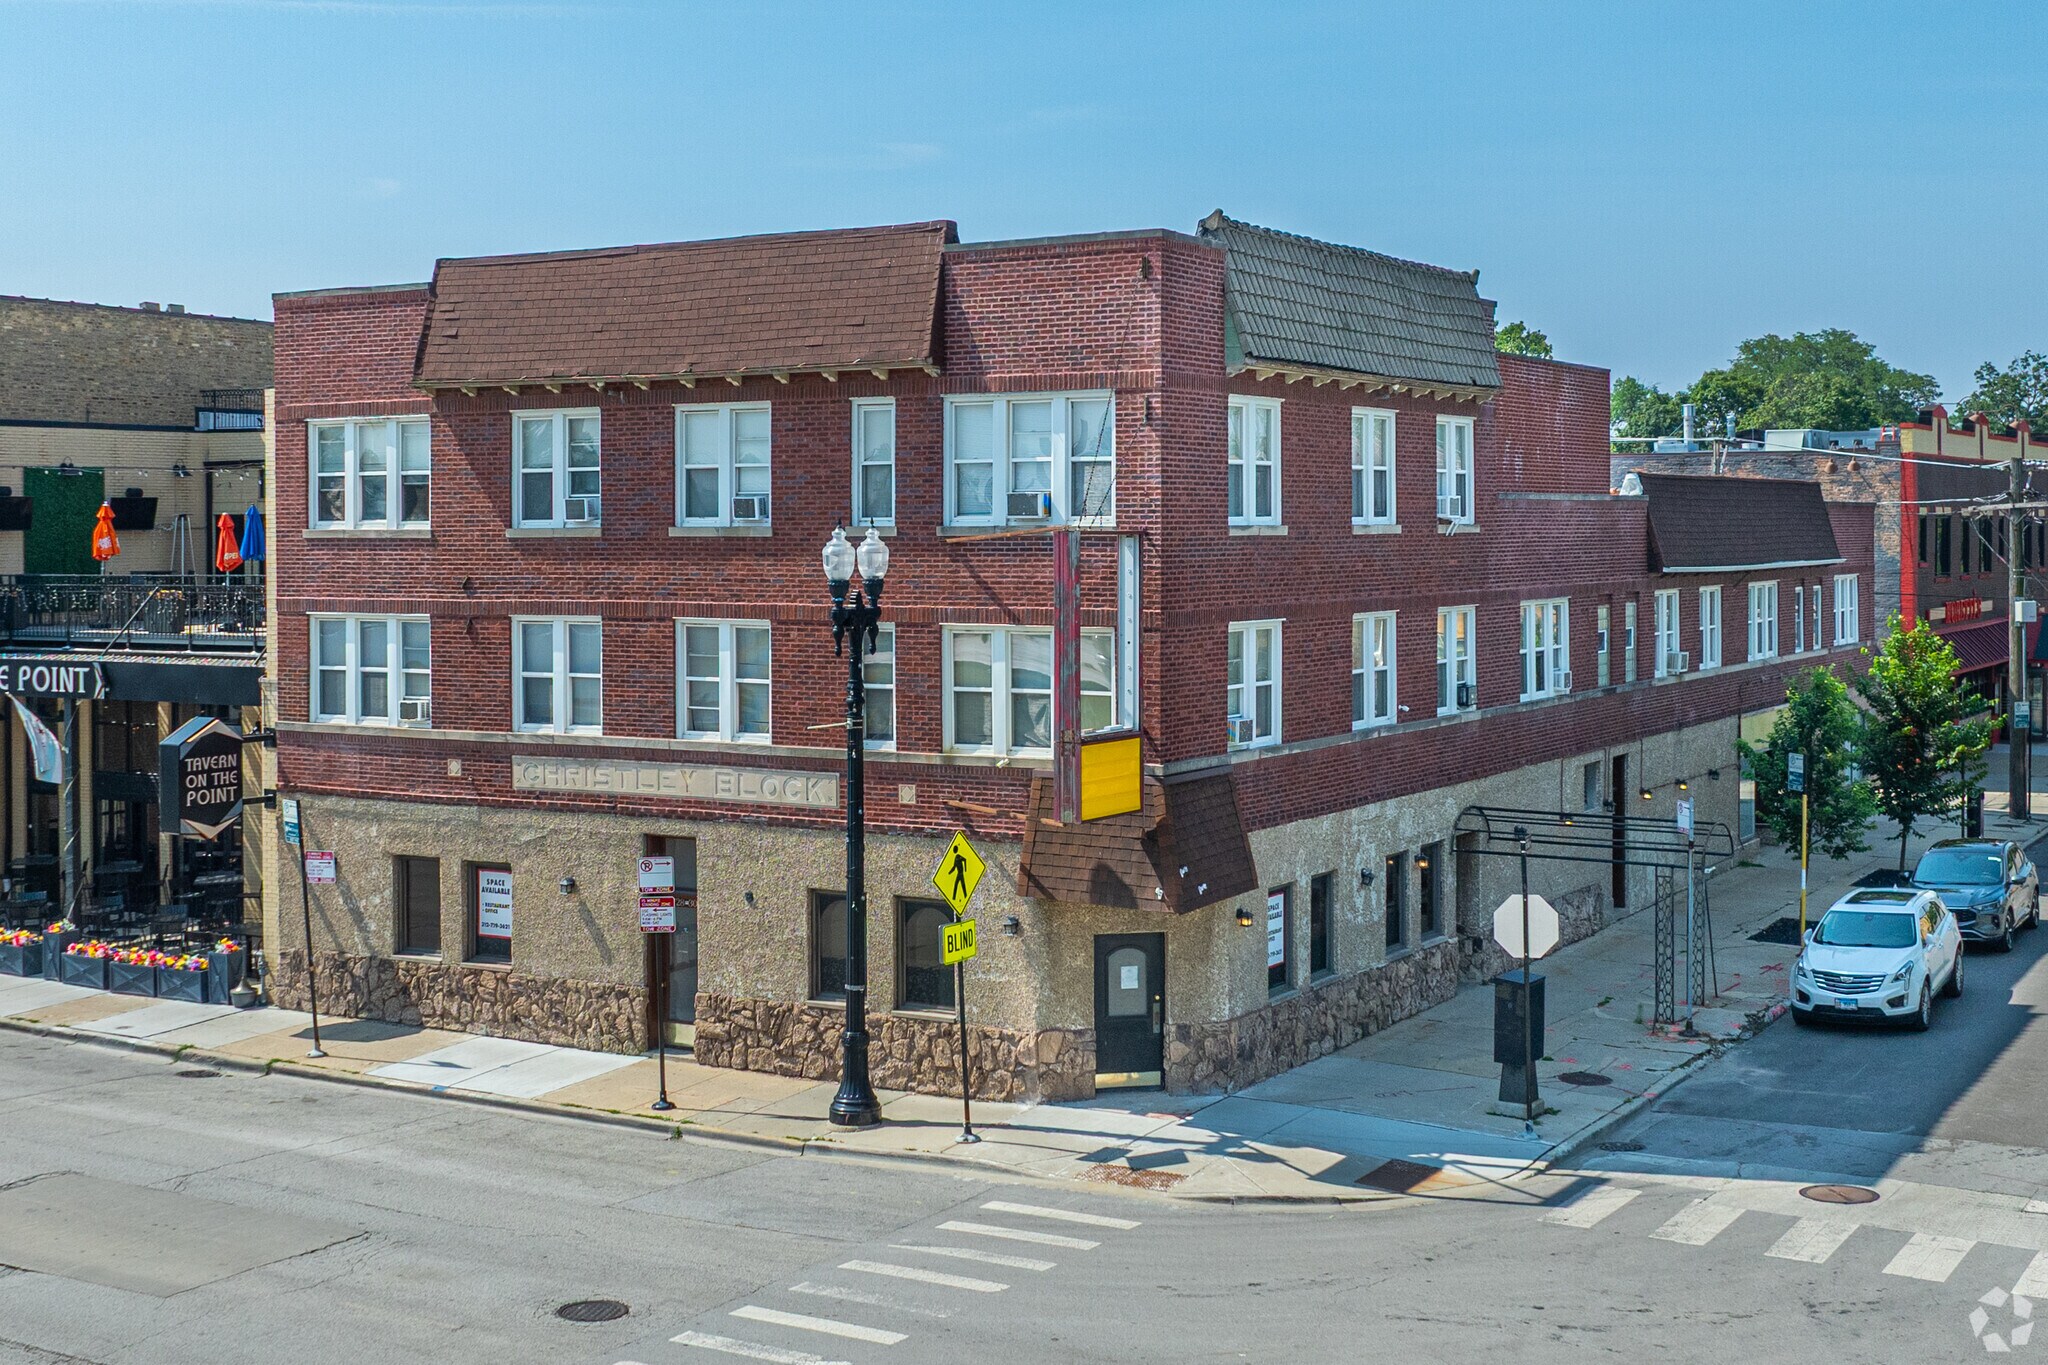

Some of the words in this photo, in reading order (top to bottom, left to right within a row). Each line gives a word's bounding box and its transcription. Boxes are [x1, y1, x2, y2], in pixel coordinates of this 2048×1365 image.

[17, 665, 91, 694] POINT
[184, 753, 238, 772] TAVERN
[185, 771, 207, 788] ON
[211, 770, 238, 785] THE
[521, 760, 698, 793] CHRISTLEY
[713, 767, 828, 804] BLOCK
[186, 786, 239, 807] POINT
[481, 886, 511, 896] AVAILABLE
[486, 878, 505, 887] SPACE
[485, 902, 510, 910] RESTAURANT
[947, 928, 974, 953] BLIND
